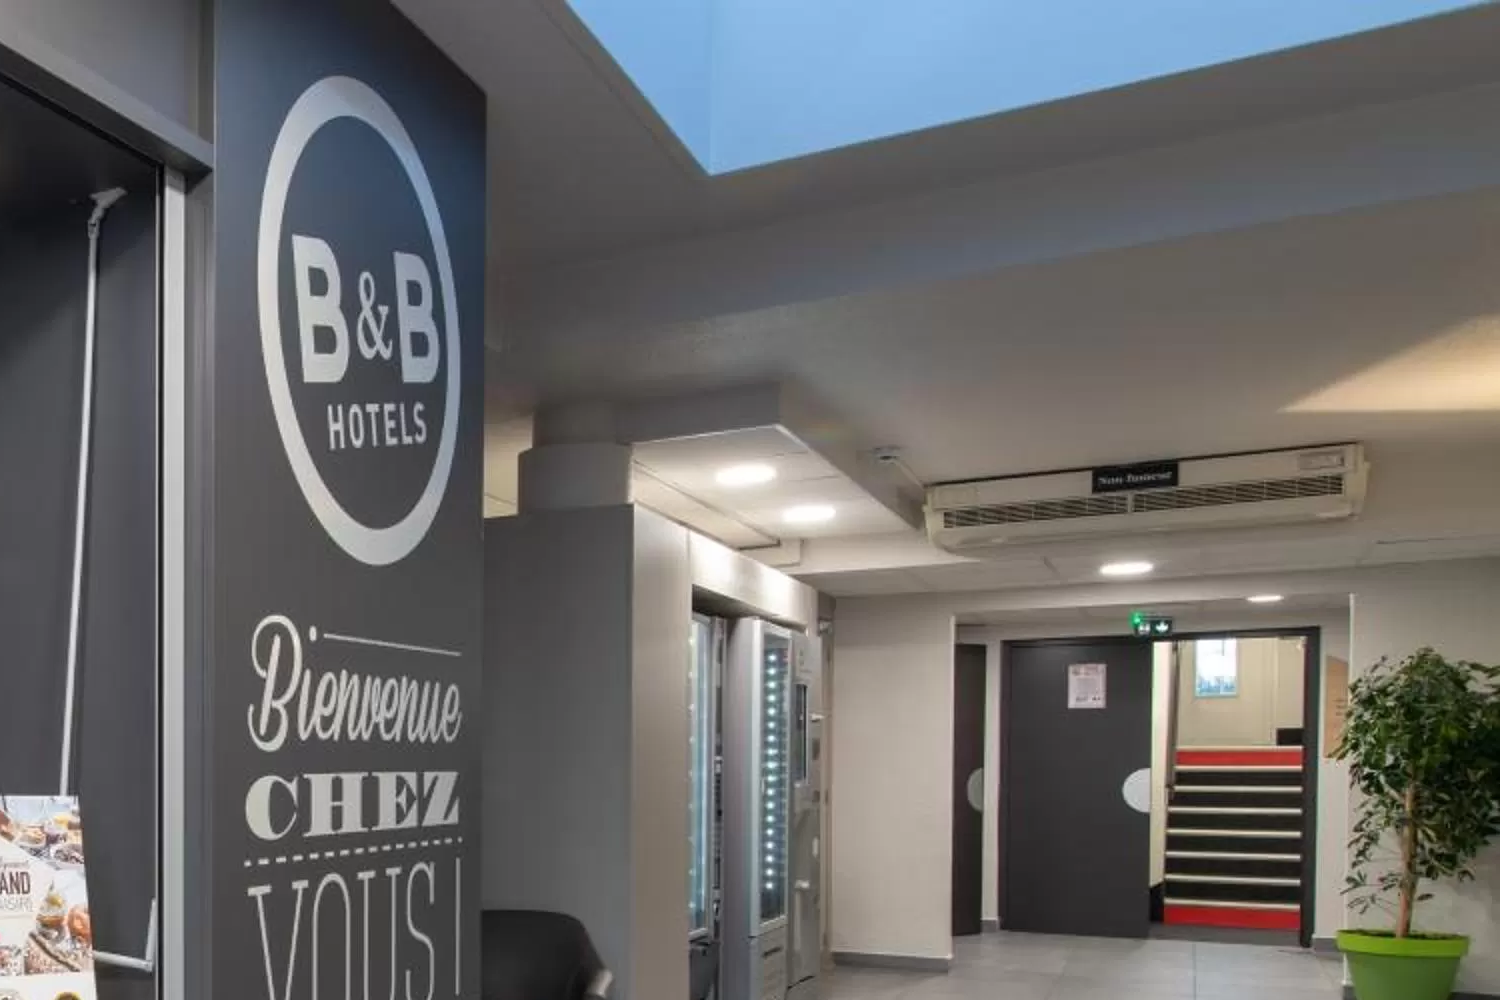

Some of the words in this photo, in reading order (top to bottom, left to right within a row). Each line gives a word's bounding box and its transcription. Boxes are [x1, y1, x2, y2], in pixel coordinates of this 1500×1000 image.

[292, 234, 439, 384] B&B
[328, 403, 428, 451] HOTELS
[247, 614, 462, 752] Bienvenue
[245, 771, 460, 841] CHEZ
